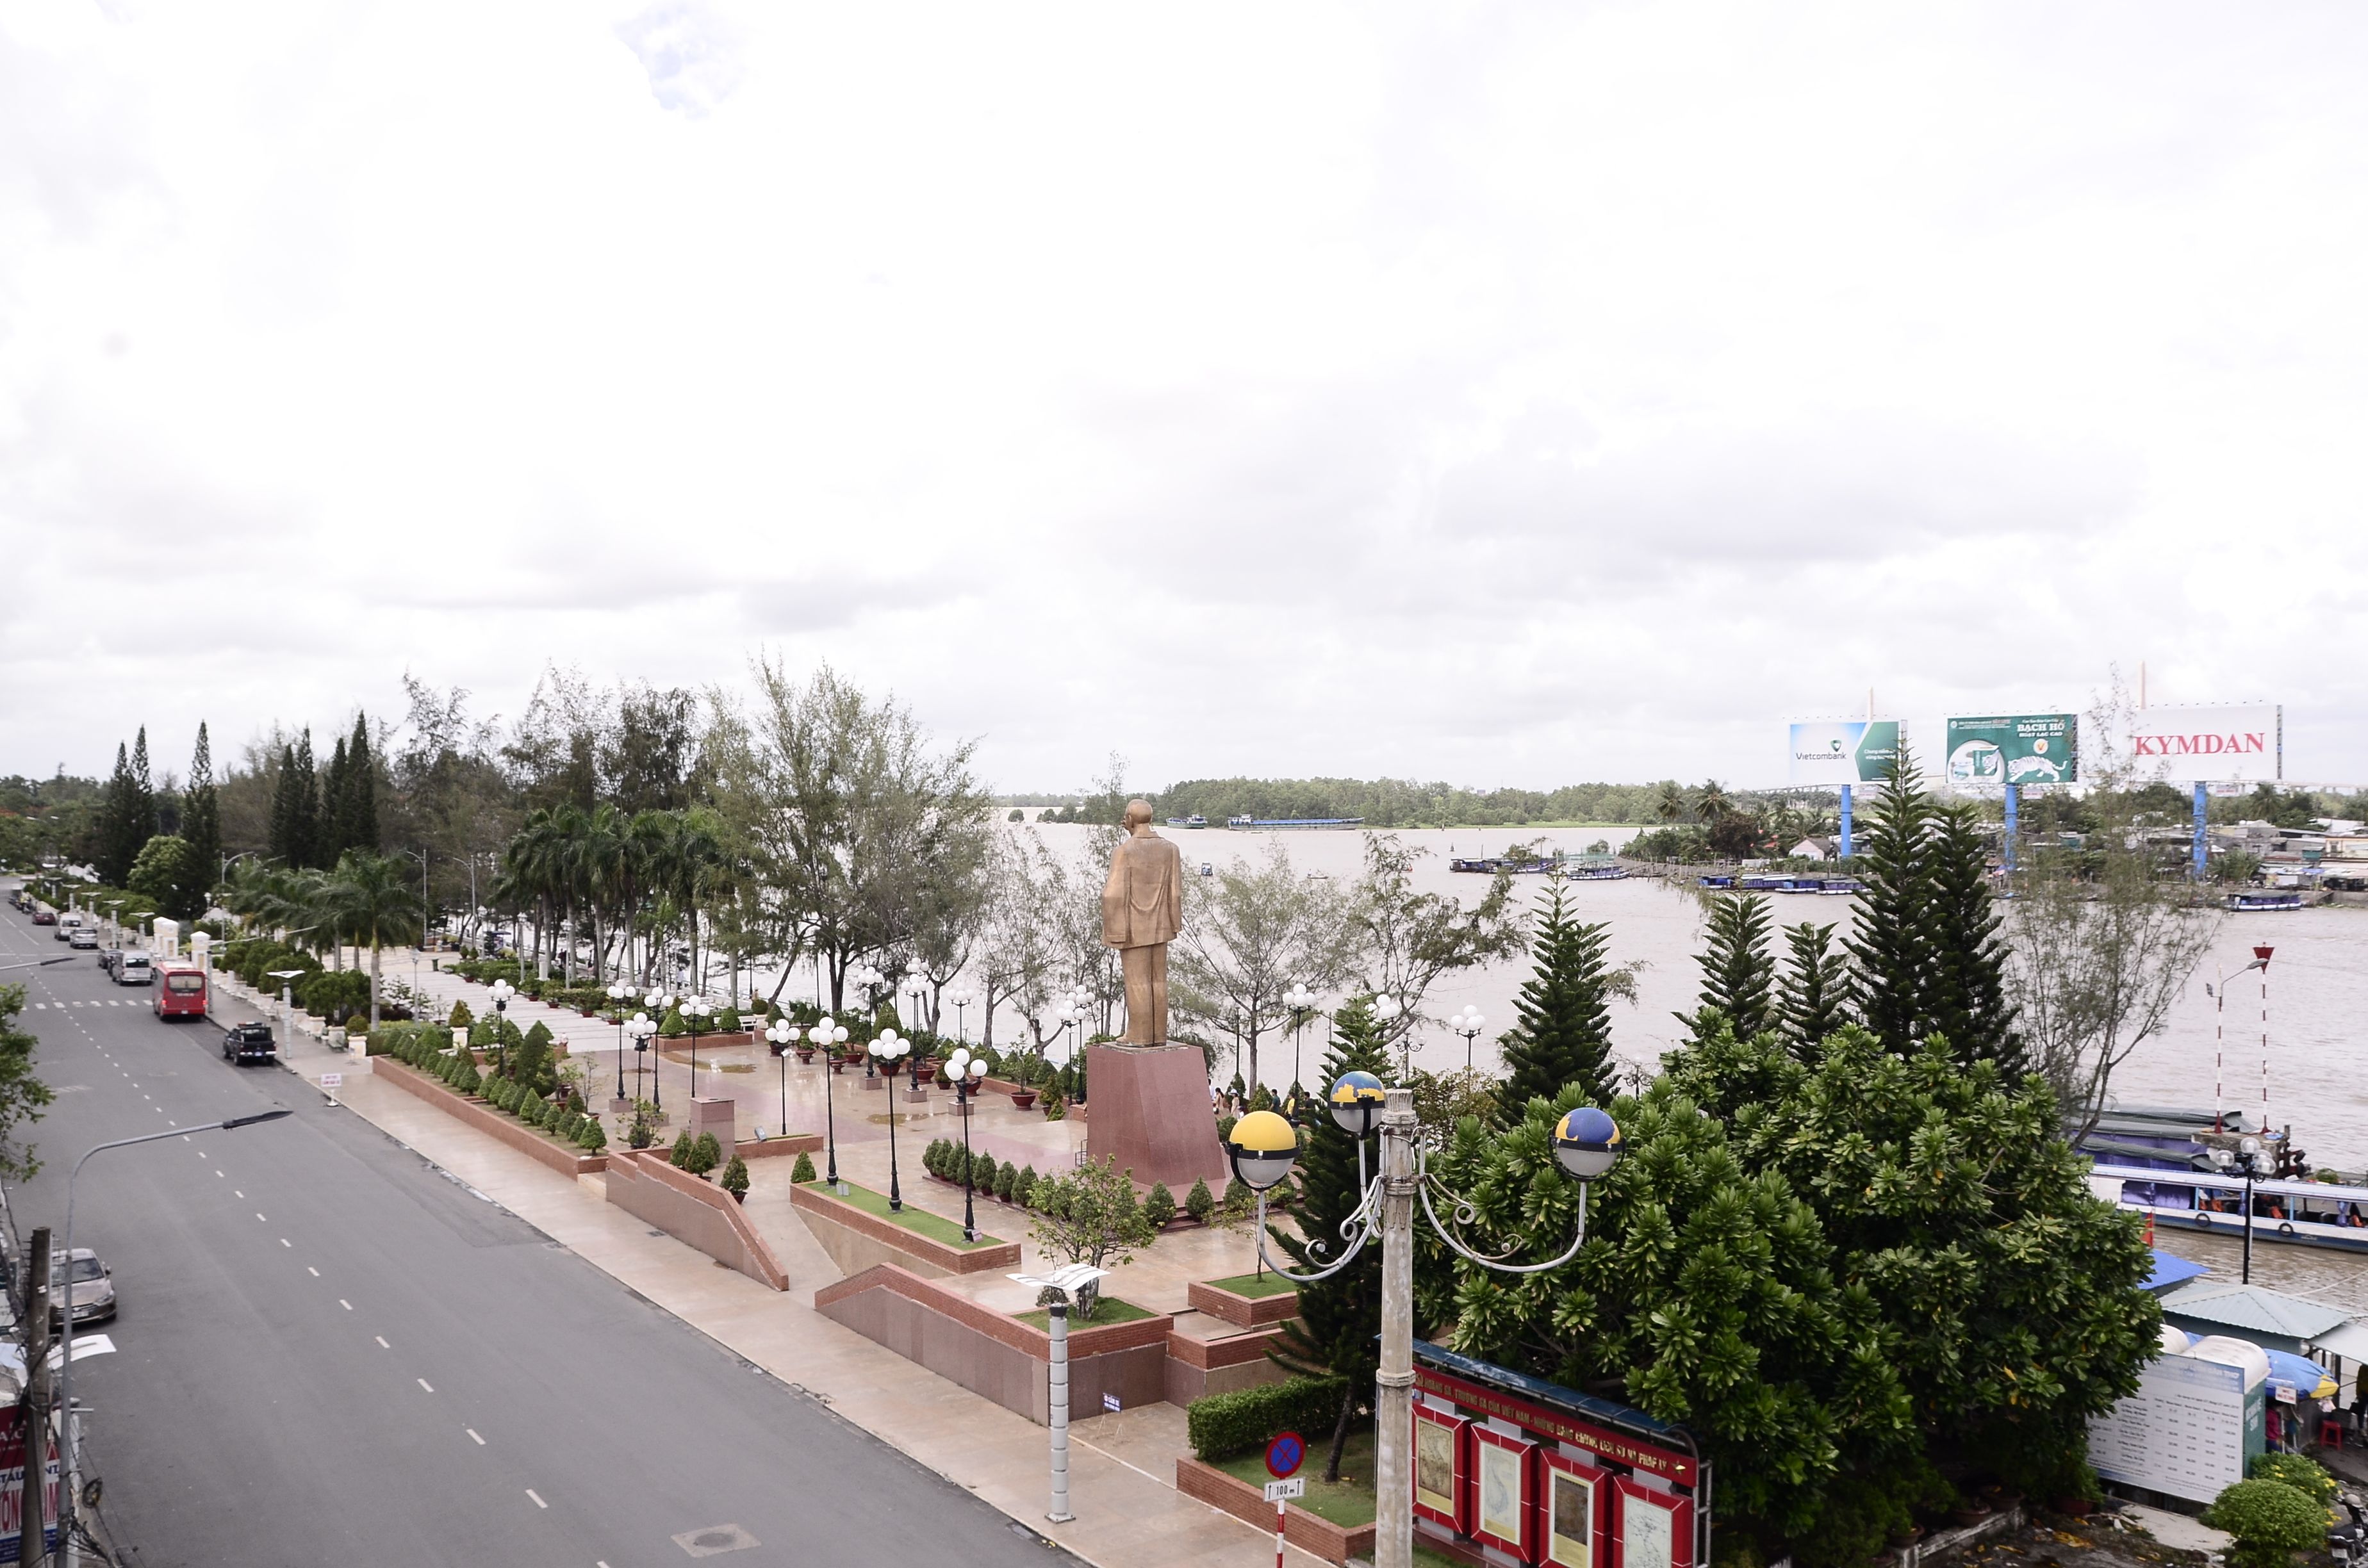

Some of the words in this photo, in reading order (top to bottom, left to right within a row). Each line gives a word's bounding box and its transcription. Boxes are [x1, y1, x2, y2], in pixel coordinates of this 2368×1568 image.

[2134, 733, 2265, 755] KYMDAN
[1796, 752, 1846, 760] Vietcombank
[1516, 1410, 1530, 1424] NAM
[1276, 1485, 1288, 1496] 100
